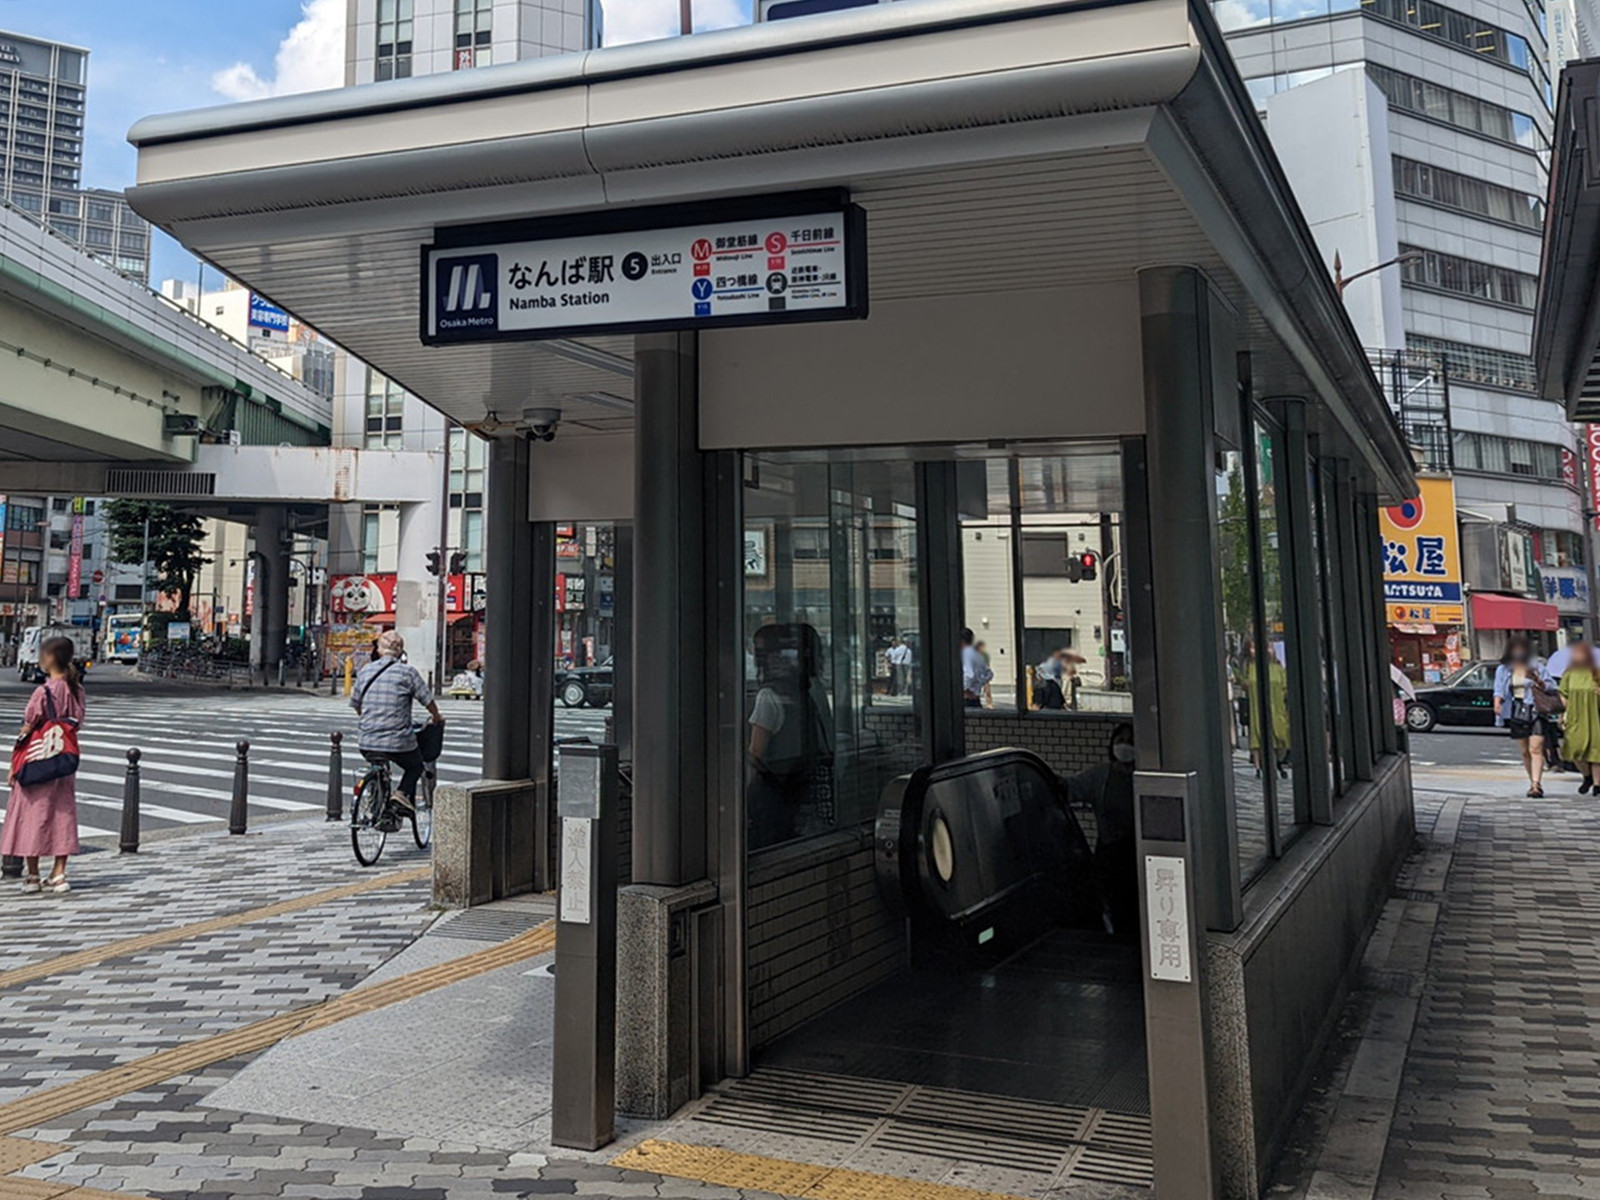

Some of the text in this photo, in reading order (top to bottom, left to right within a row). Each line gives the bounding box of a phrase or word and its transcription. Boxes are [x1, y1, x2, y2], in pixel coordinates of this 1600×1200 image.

[716, 234, 758, 248] 御堂筋線
[791, 227, 834, 242] 千日前線
[651, 252, 682, 267] 出入口
[508, 255, 615, 290] なんば駅
[716, 274, 758, 288] 四つ橋線
[509, 291, 610, 310] Namba Station
[439, 317, 494, 328] Osaka Metro
[566, 824, 586, 912] 進入禁止
[1154, 868, 1182, 968] 昇り専用
